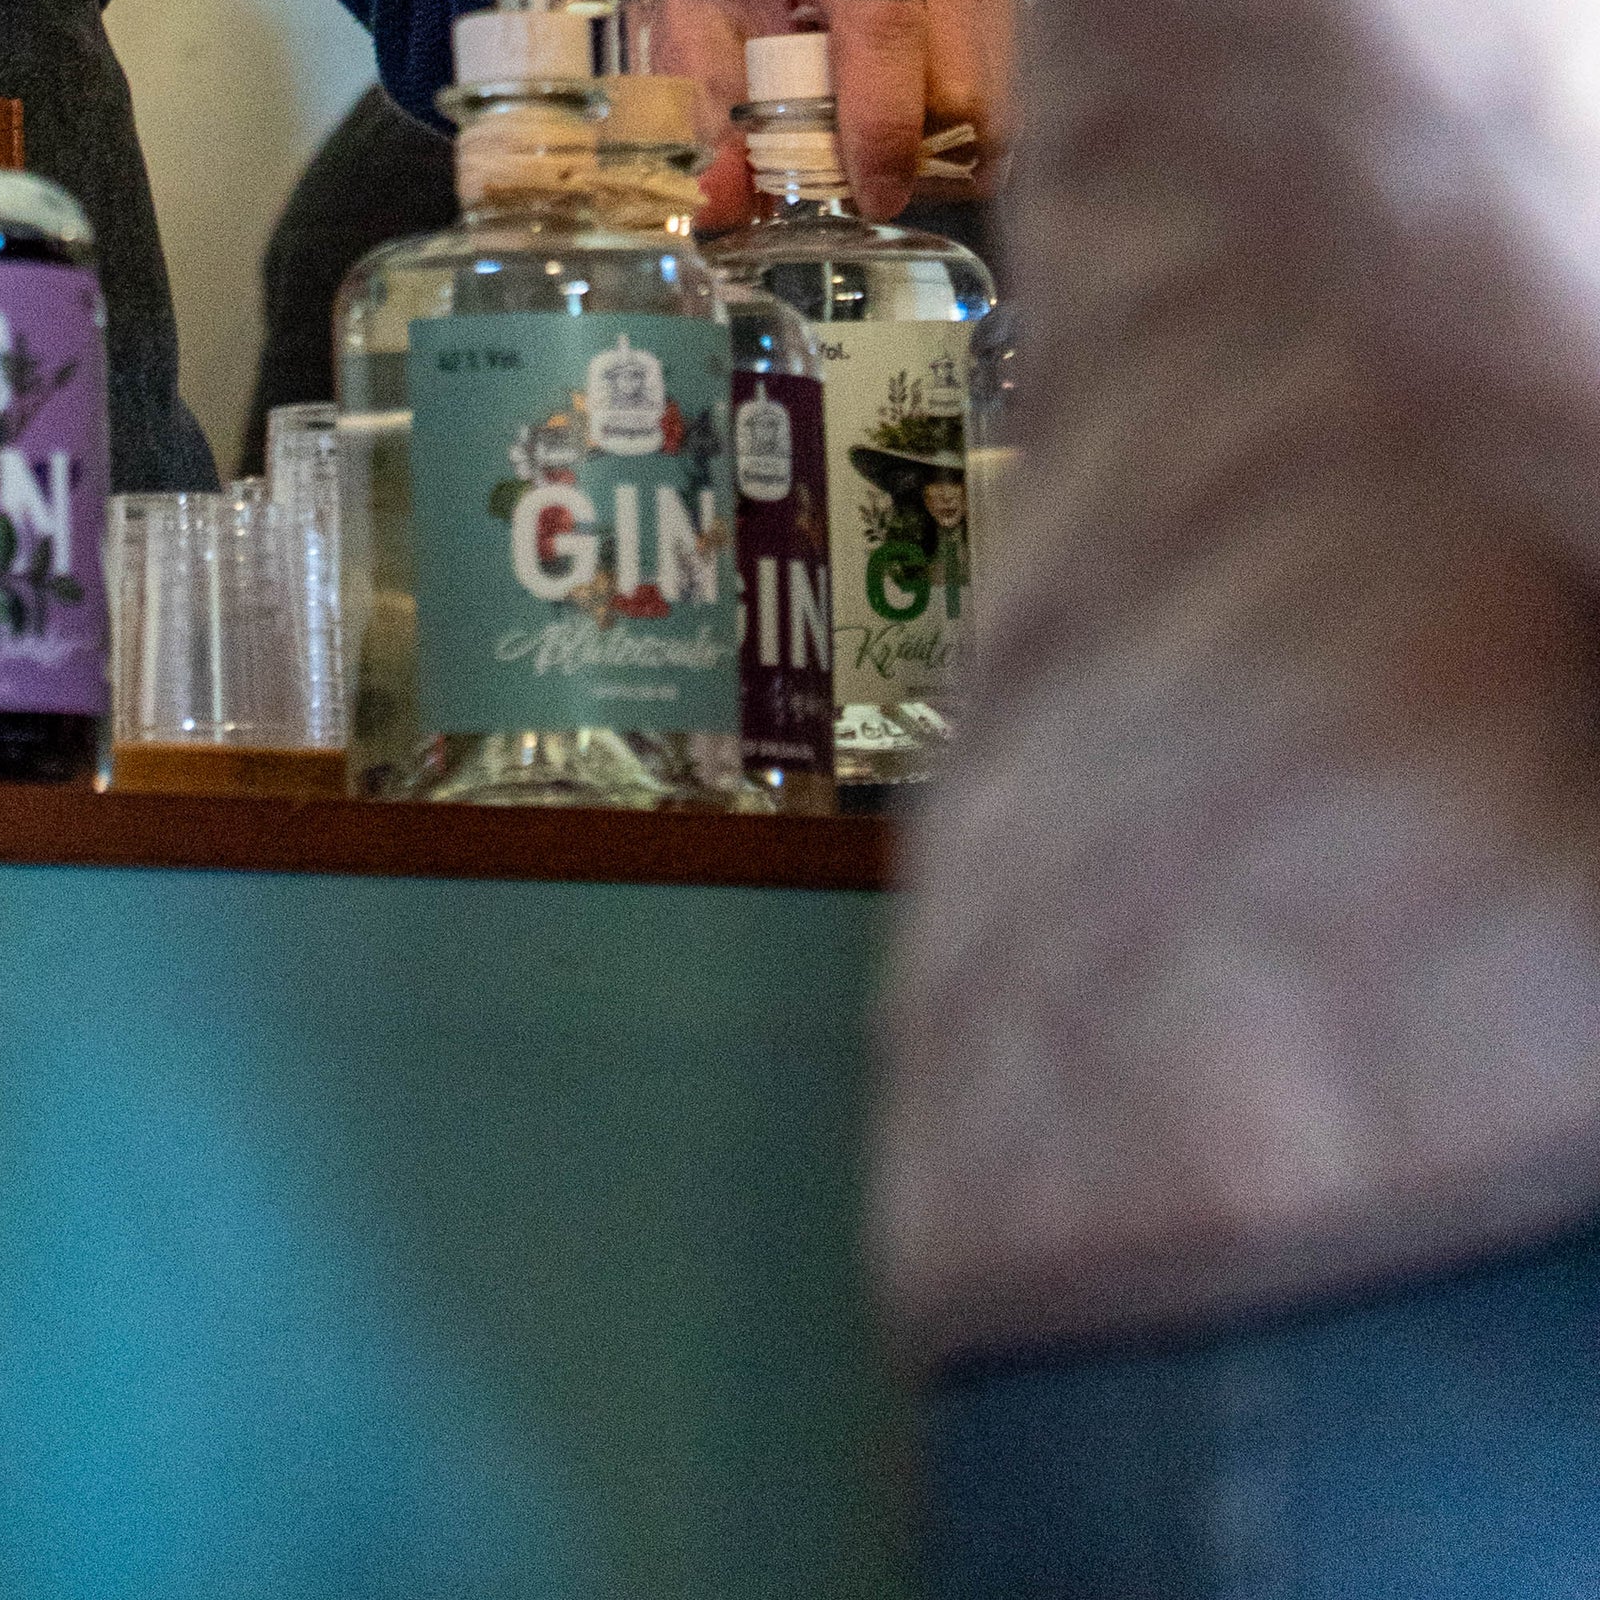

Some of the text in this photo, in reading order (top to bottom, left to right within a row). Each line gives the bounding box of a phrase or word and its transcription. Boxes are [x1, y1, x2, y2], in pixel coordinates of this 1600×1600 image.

[510, 482, 720, 603] GIN
[865, 541, 962, 622] GI
[737, 556, 832, 673] IN
